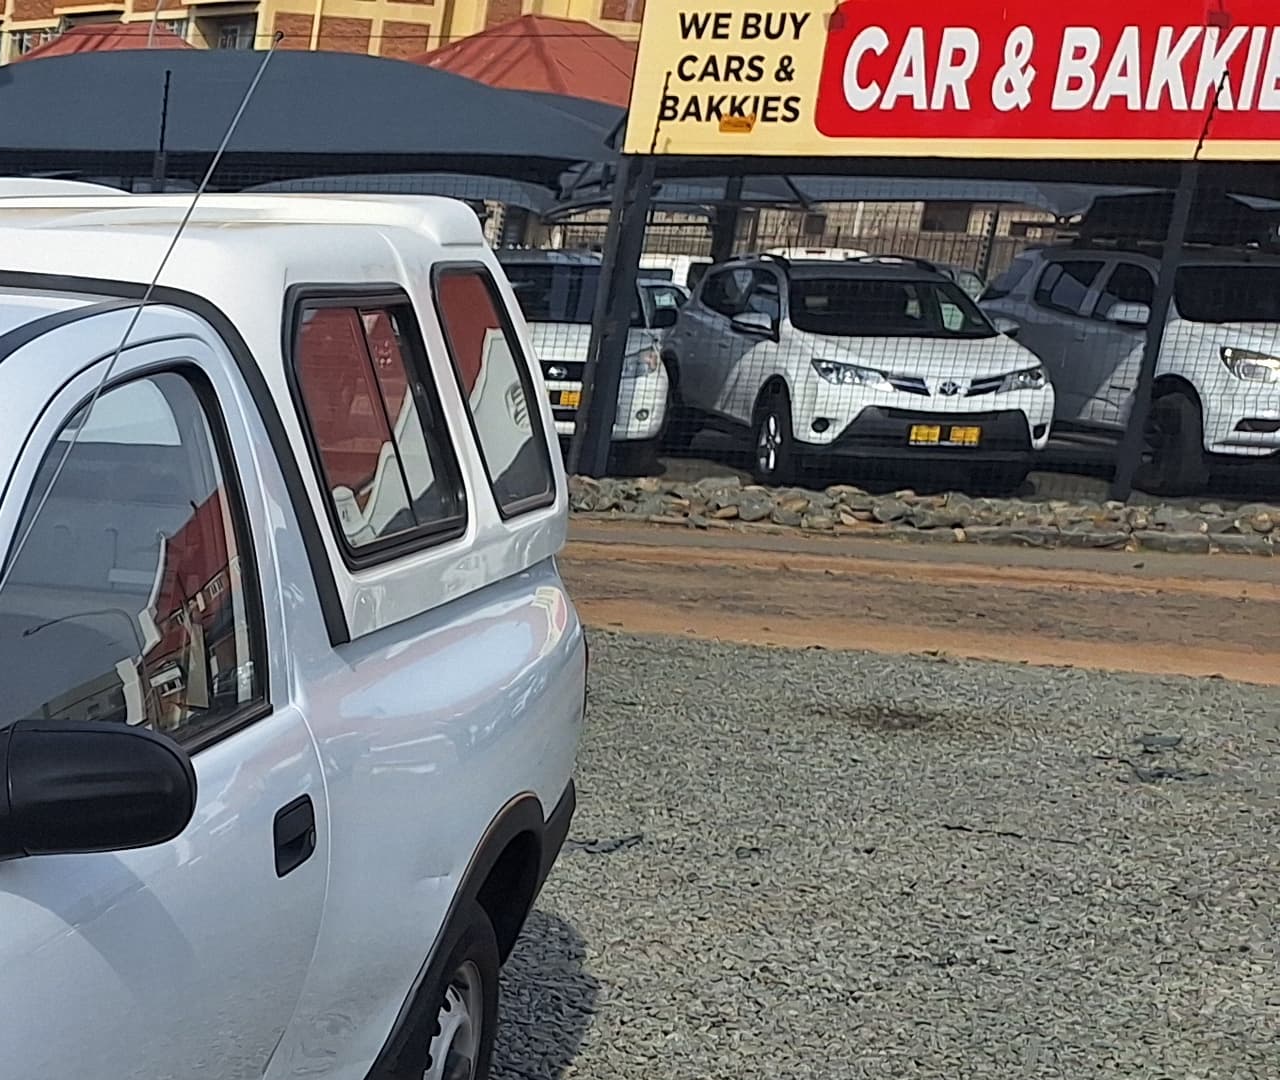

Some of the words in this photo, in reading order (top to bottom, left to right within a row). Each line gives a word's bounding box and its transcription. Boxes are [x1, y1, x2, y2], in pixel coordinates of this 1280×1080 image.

[679, 12, 732, 40] WE
[740, 12, 811, 40] BUY
[676, 55, 766, 82] CARS
[774, 55, 795, 82] &
[842, 25, 980, 112] CAR
[991, 25, 1037, 112] &
[659, 95, 802, 122] BAKKIES
